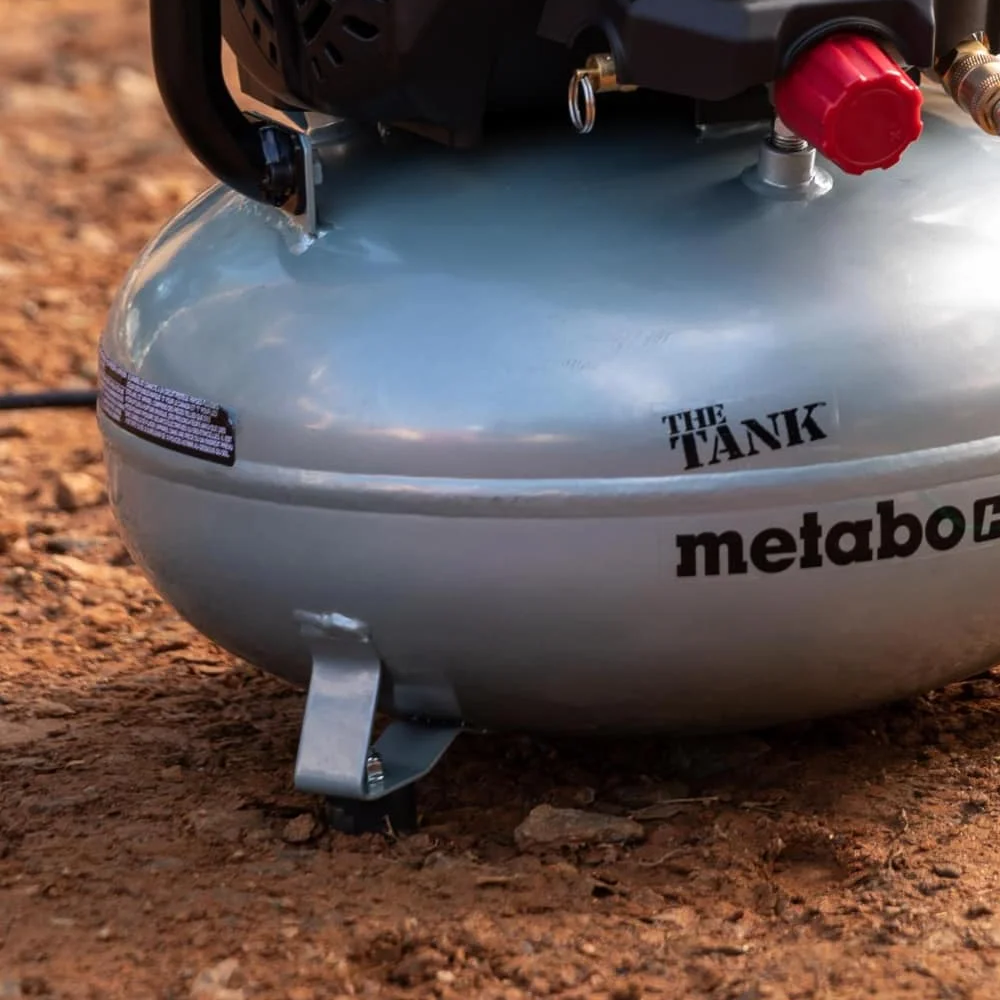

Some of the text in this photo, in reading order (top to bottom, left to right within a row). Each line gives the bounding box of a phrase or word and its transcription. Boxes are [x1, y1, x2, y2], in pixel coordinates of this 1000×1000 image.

[662, 403, 727, 435] THE
[669, 401, 828, 470] TANK
[677, 499, 966, 577] metabo
